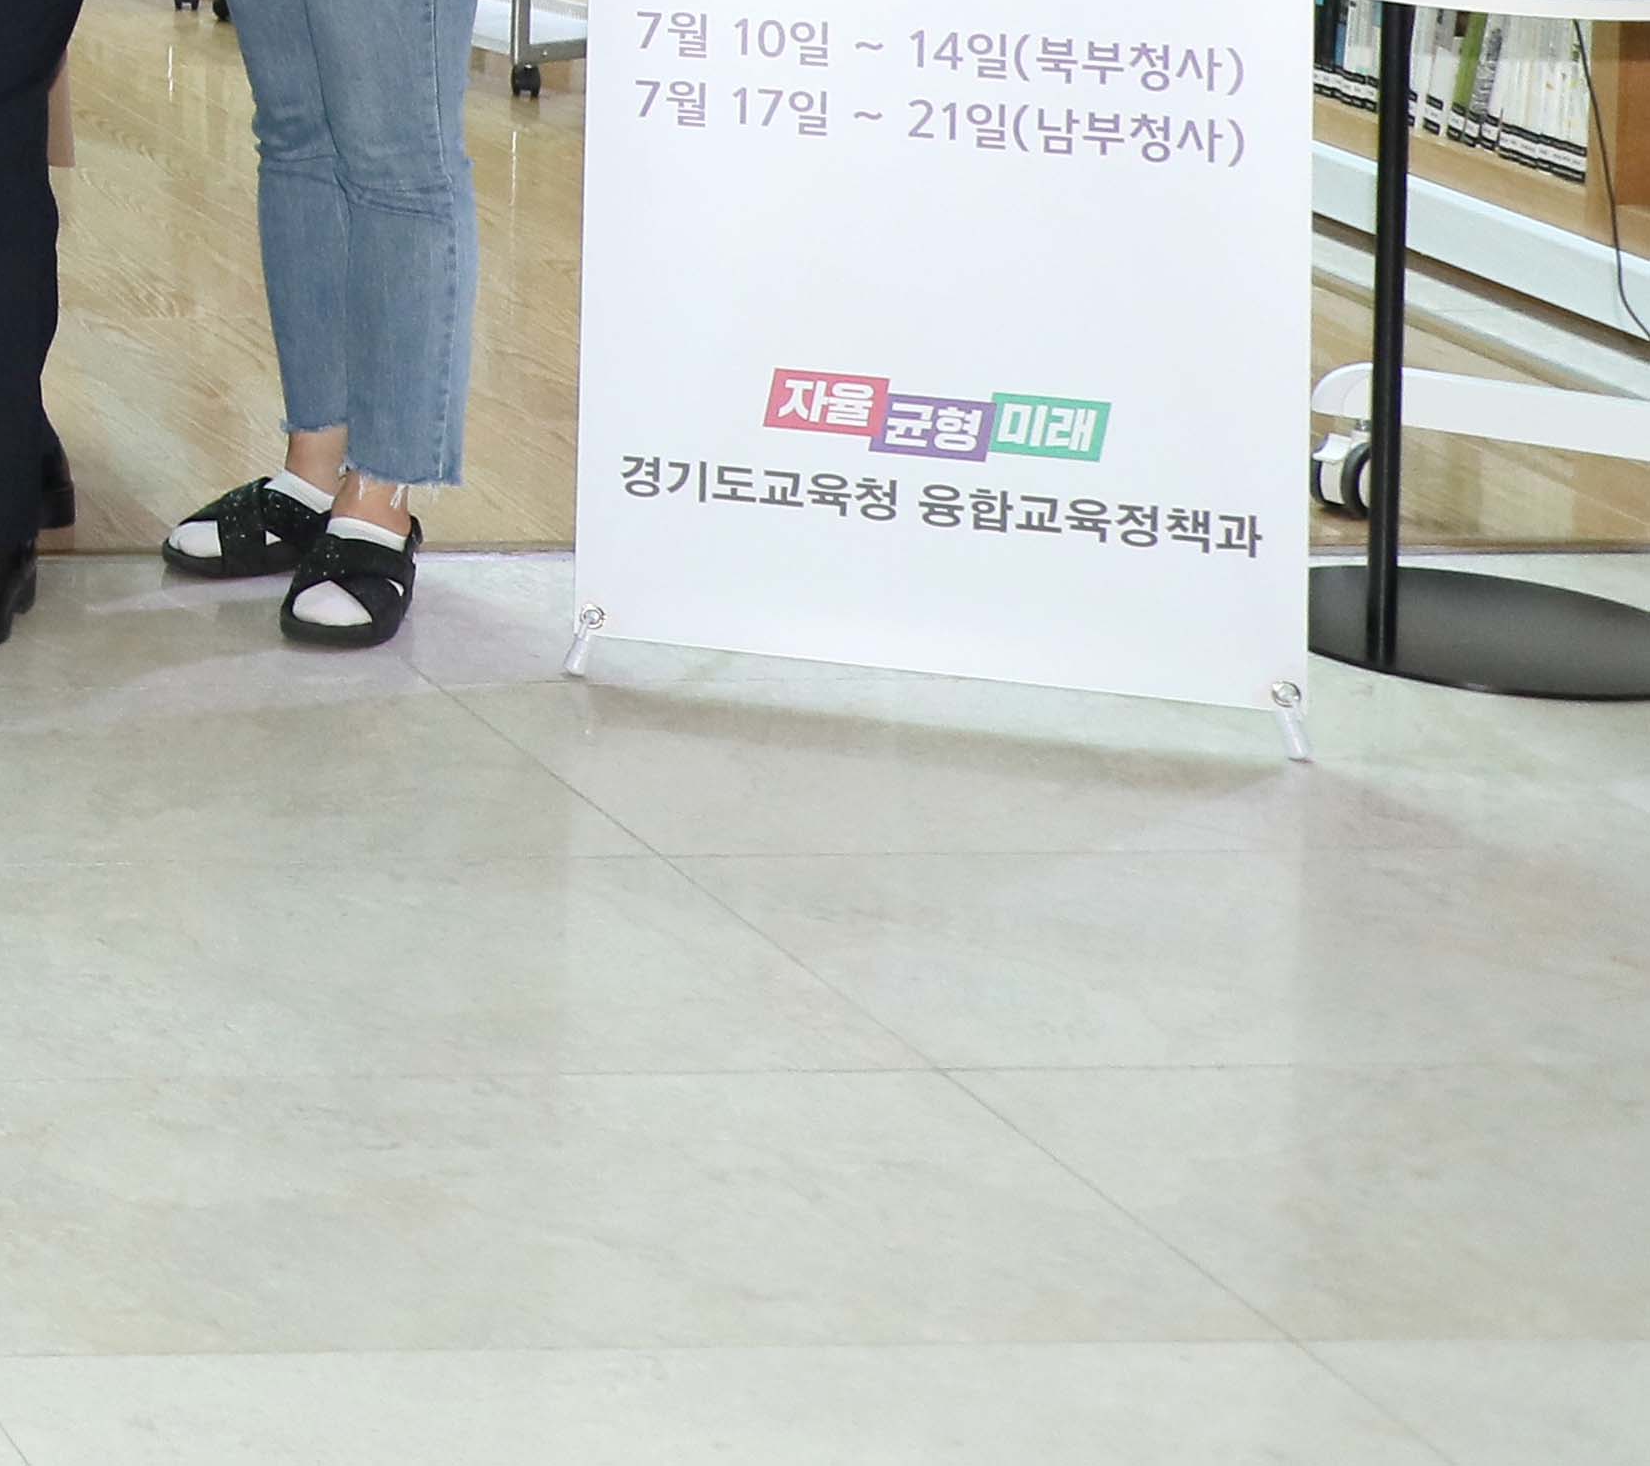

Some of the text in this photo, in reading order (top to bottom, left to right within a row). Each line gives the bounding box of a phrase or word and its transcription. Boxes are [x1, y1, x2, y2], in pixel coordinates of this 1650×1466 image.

[635, 10, 709, 60] 7월
[733, 16, 830, 68] 10일
[908, 27, 1246, 96] 14일(북부청사)
[635, 79, 709, 128] 7월
[732, 88, 829, 137] 17일
[907, 98, 1246, 167] 21일(남부청사)
[776, 378, 1098, 454] 자율 균형 미래
[620, 454, 1264, 559] 경기도교육청 융합교육정책과
